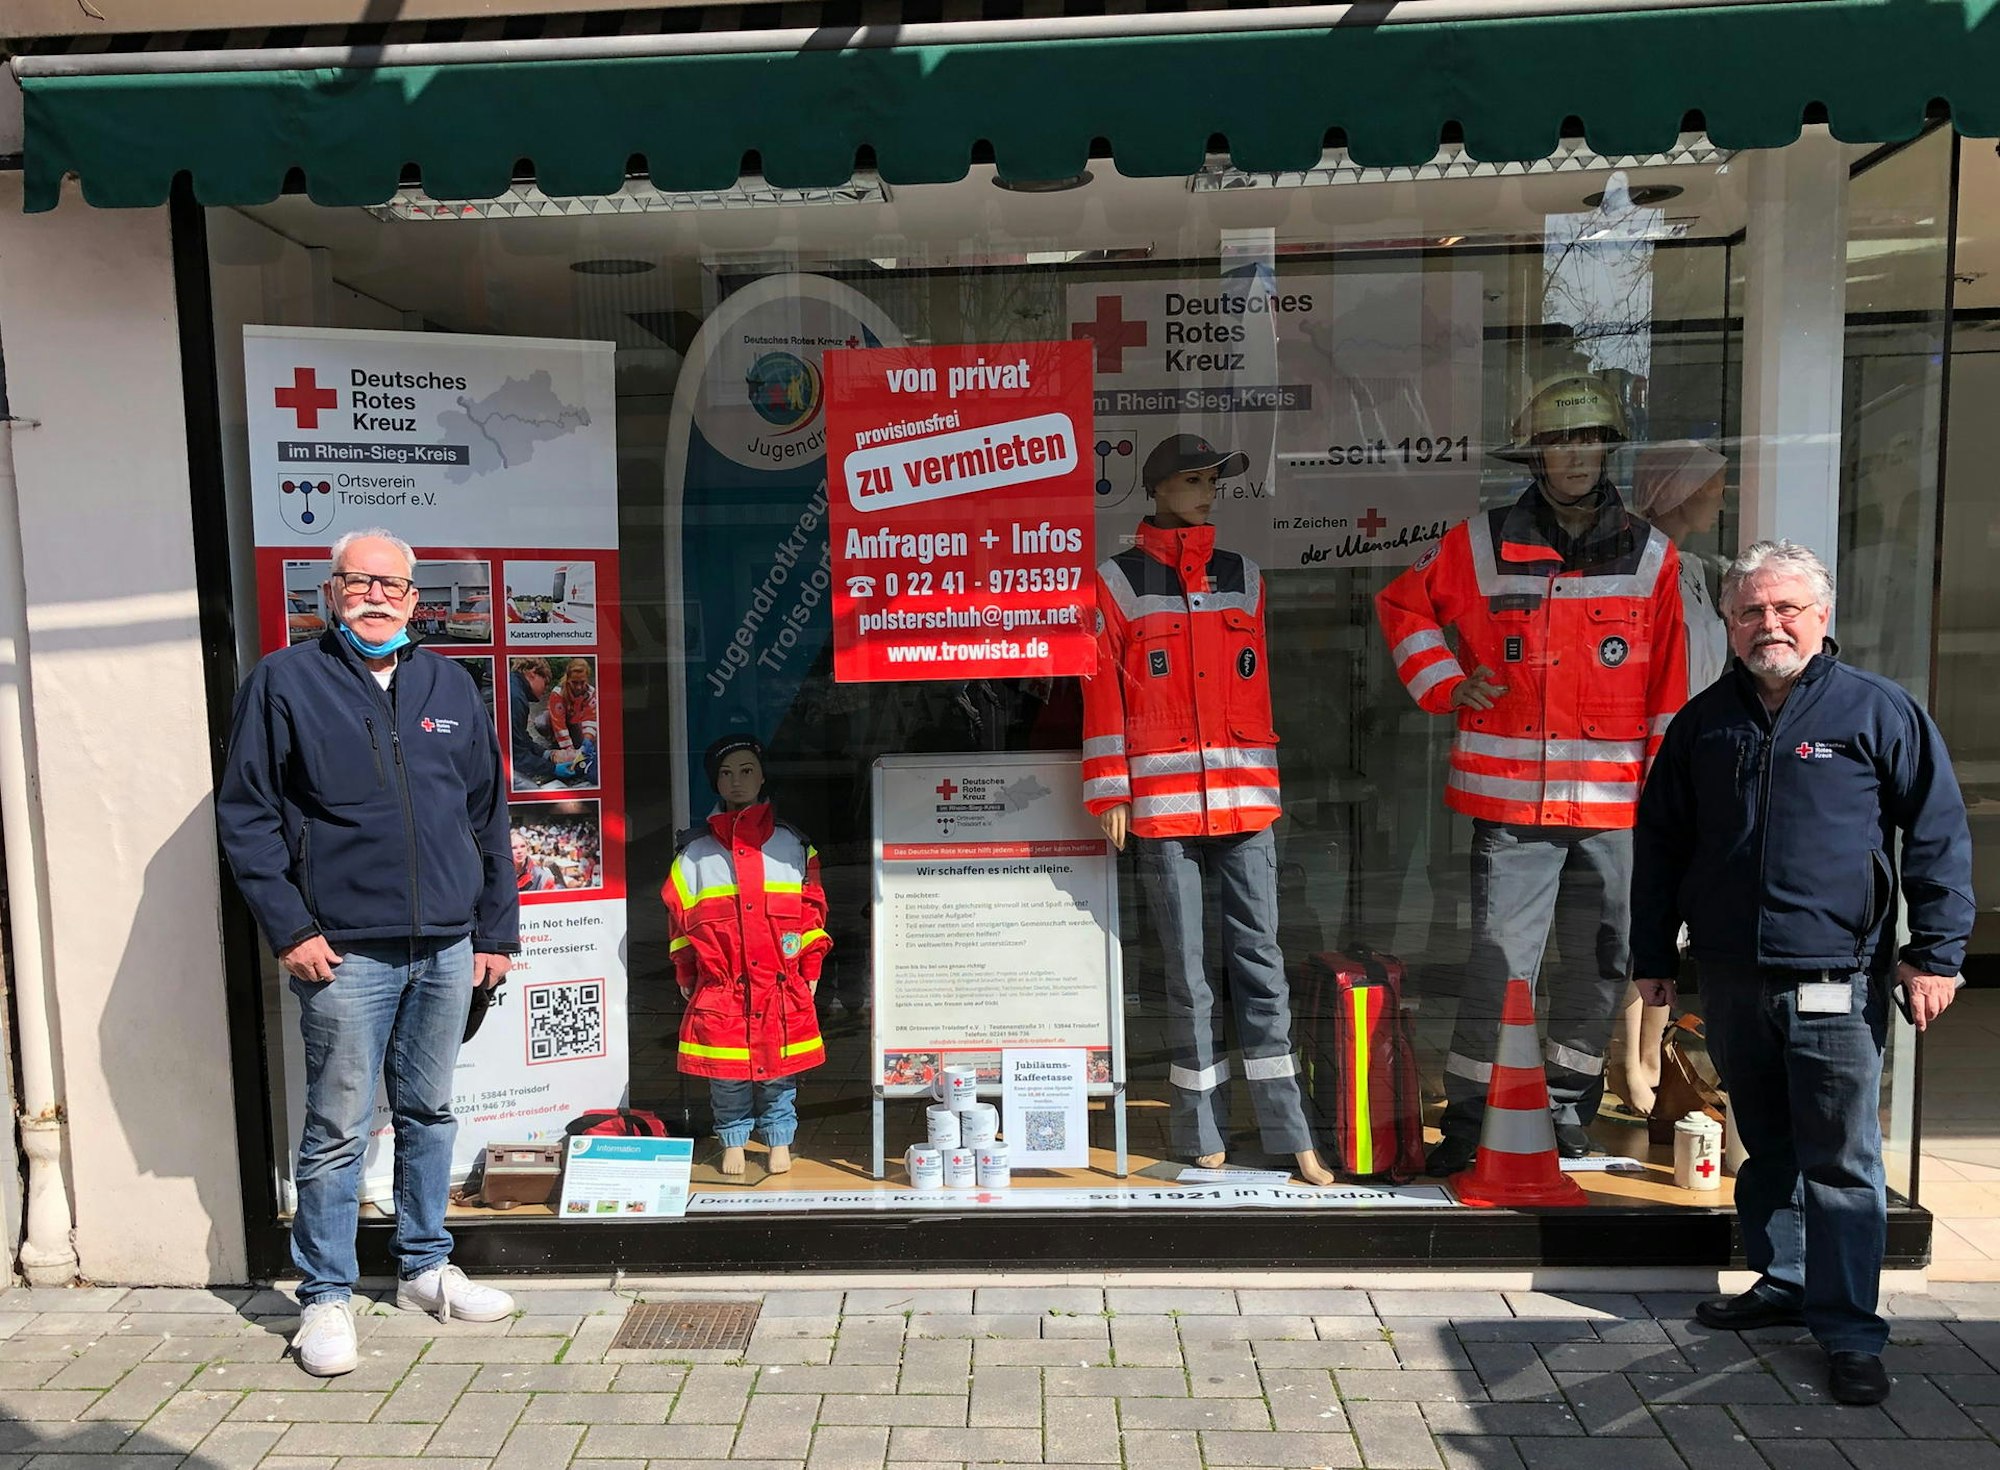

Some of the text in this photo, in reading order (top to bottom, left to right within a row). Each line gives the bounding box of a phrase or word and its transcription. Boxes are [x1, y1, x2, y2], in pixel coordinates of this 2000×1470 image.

[1165, 292, 1313, 316] Deutsches
[744, 336, 843, 346] Deutsches Rotes Kreuz
[1165, 321, 1246, 344] Rotes
[1165, 349, 1246, 372] Kreuz
[351, 368, 468, 392] Deutsches
[886, 358, 1030, 398] von privat
[352, 390, 416, 411] Rotes
[1117, 388, 1296, 412] Rhein-Sieg-Kreis
[353, 412, 417, 432] Kreuz
[855, 410, 961, 450] provisionsfrei
[288, 444, 458, 464] im Rhein-Sieg-Kreis
[1397, 435, 1469, 464] 1921
[855, 432, 1068, 498] zu vermieten
[337, 473, 416, 489] Ortsverein
[1233, 482, 1266, 500] e.V.
[338, 490, 438, 507] Troisdorf e.V.
[1273, 516, 1348, 529] im Zeichen
[844, 522, 1083, 565] Anfragen + Infos
[1300, 544, 1332, 565] der
[885, 572, 898, 597] 0
[907, 571, 933, 596] 22
[941, 571, 965, 595] 41
[989, 567, 1082, 594] 9735397
[757, 541, 831, 673] Troisdorf
[859, 604, 1077, 635] polsterschuh@gmx.net
[509, 629, 594, 641] Katastrophenschutz
[887, 638, 1049, 663] www.trowista.de
[916, 864, 1073, 876] Wir schaffen es nicht alleine.
[529, 920, 540, 929] in
[543, 919, 563, 928] Not
[566, 916, 604, 927] helfen.
[518, 934, 552, 943] Kreuz.
[526, 943, 597, 956] interessierst.
[1015, 1061, 1071, 1071] Jubiläums-
[1014, 1073, 1073, 1081] Kaffeetasse
[481, 1090, 507, 1100] 53844
[509, 1083, 551, 1096] Troisdorf
[454, 1099, 516, 1114] 02241 946 736
[473, 1103, 570, 1123] www.drk-troisdorf.de
[1148, 1190, 1221, 1200] 1921
[1234, 1188, 1258, 1197] in
[1267, 1188, 1398, 1200] Troisdorf
